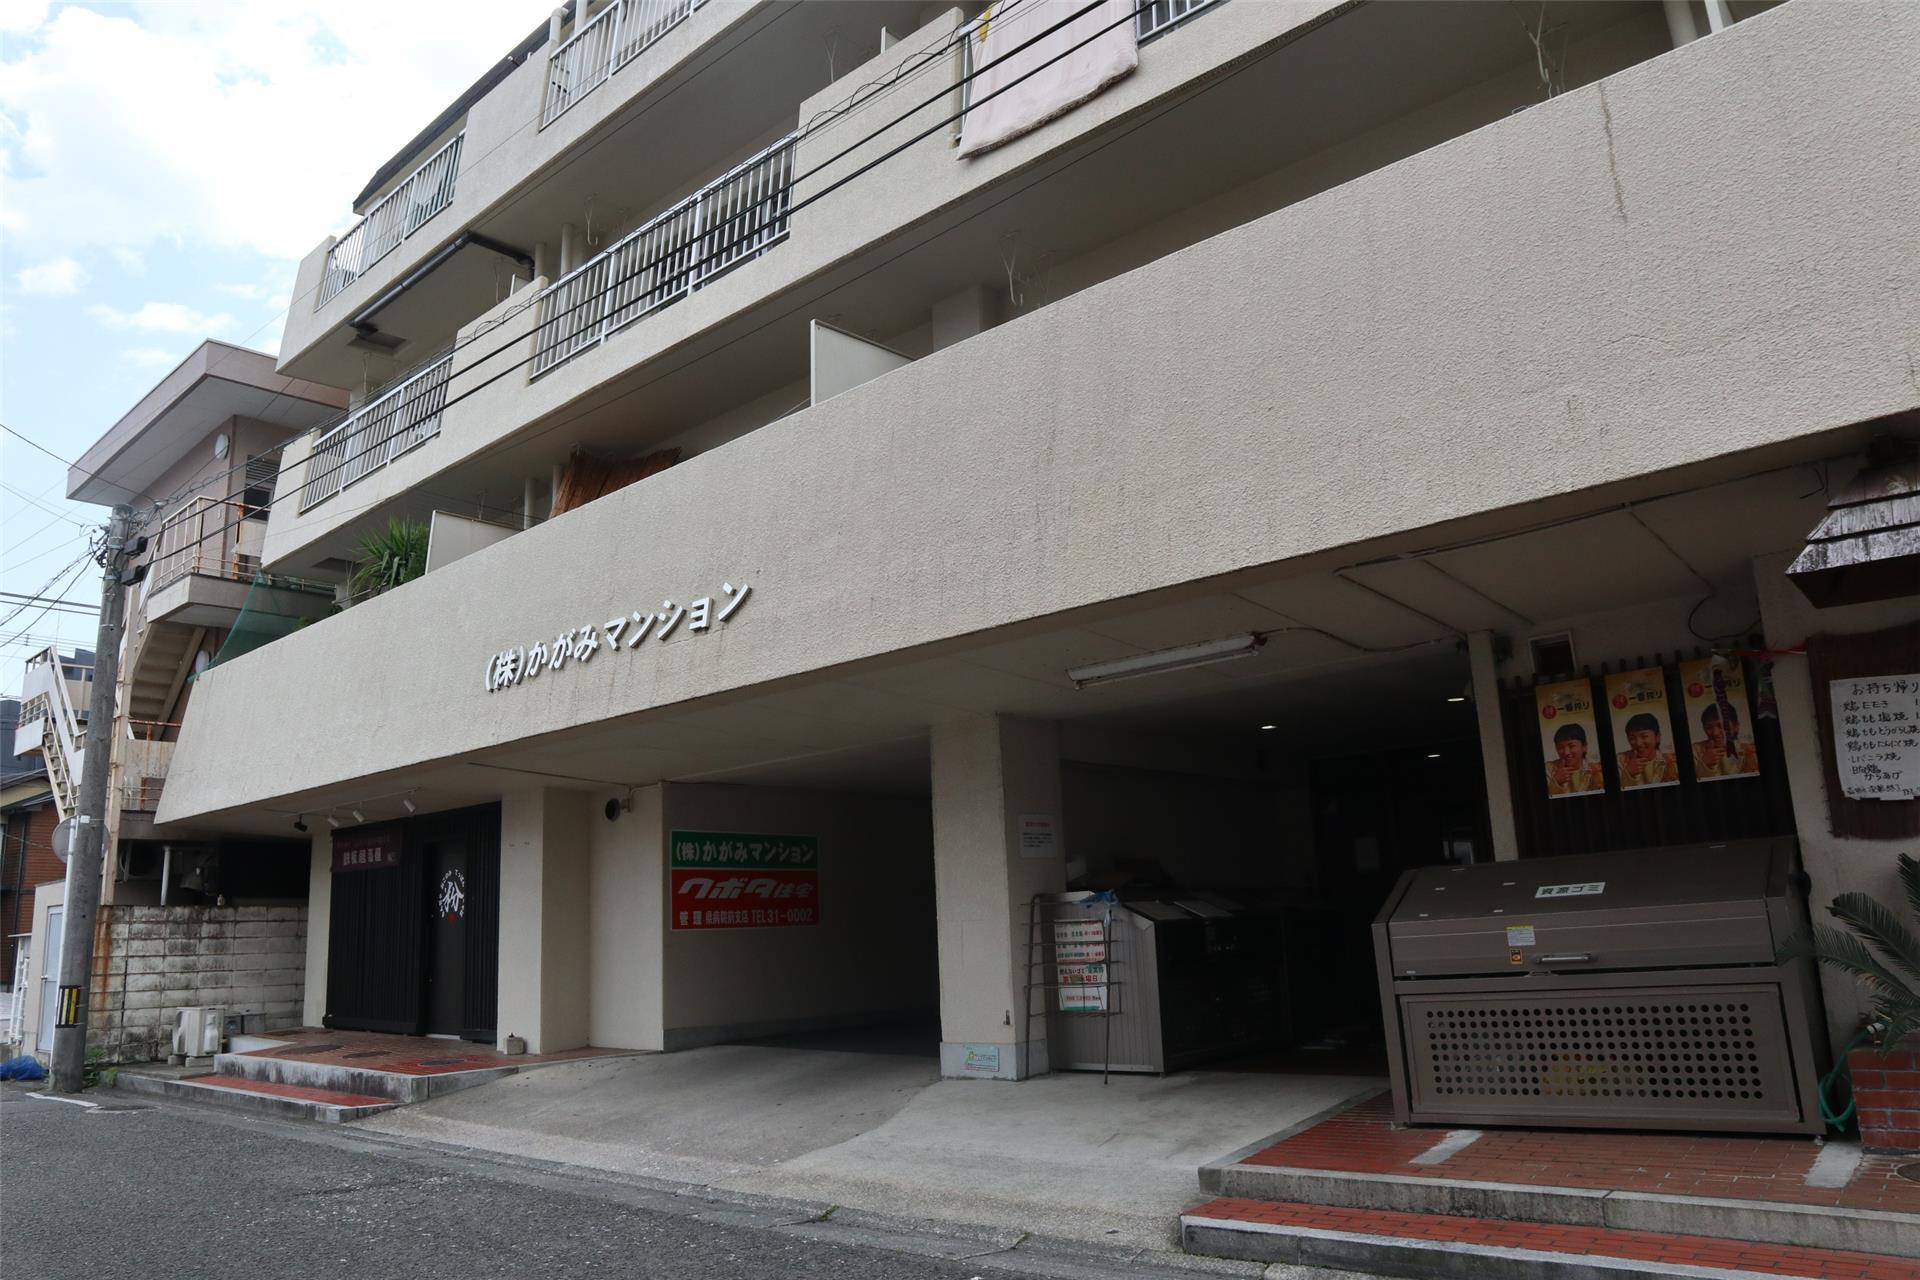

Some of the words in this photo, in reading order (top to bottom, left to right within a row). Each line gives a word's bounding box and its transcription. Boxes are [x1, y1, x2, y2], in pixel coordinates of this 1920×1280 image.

[485, 582, 751, 692] (株)かがみマンション
[675, 840, 815, 864] (株)かがみマンション
